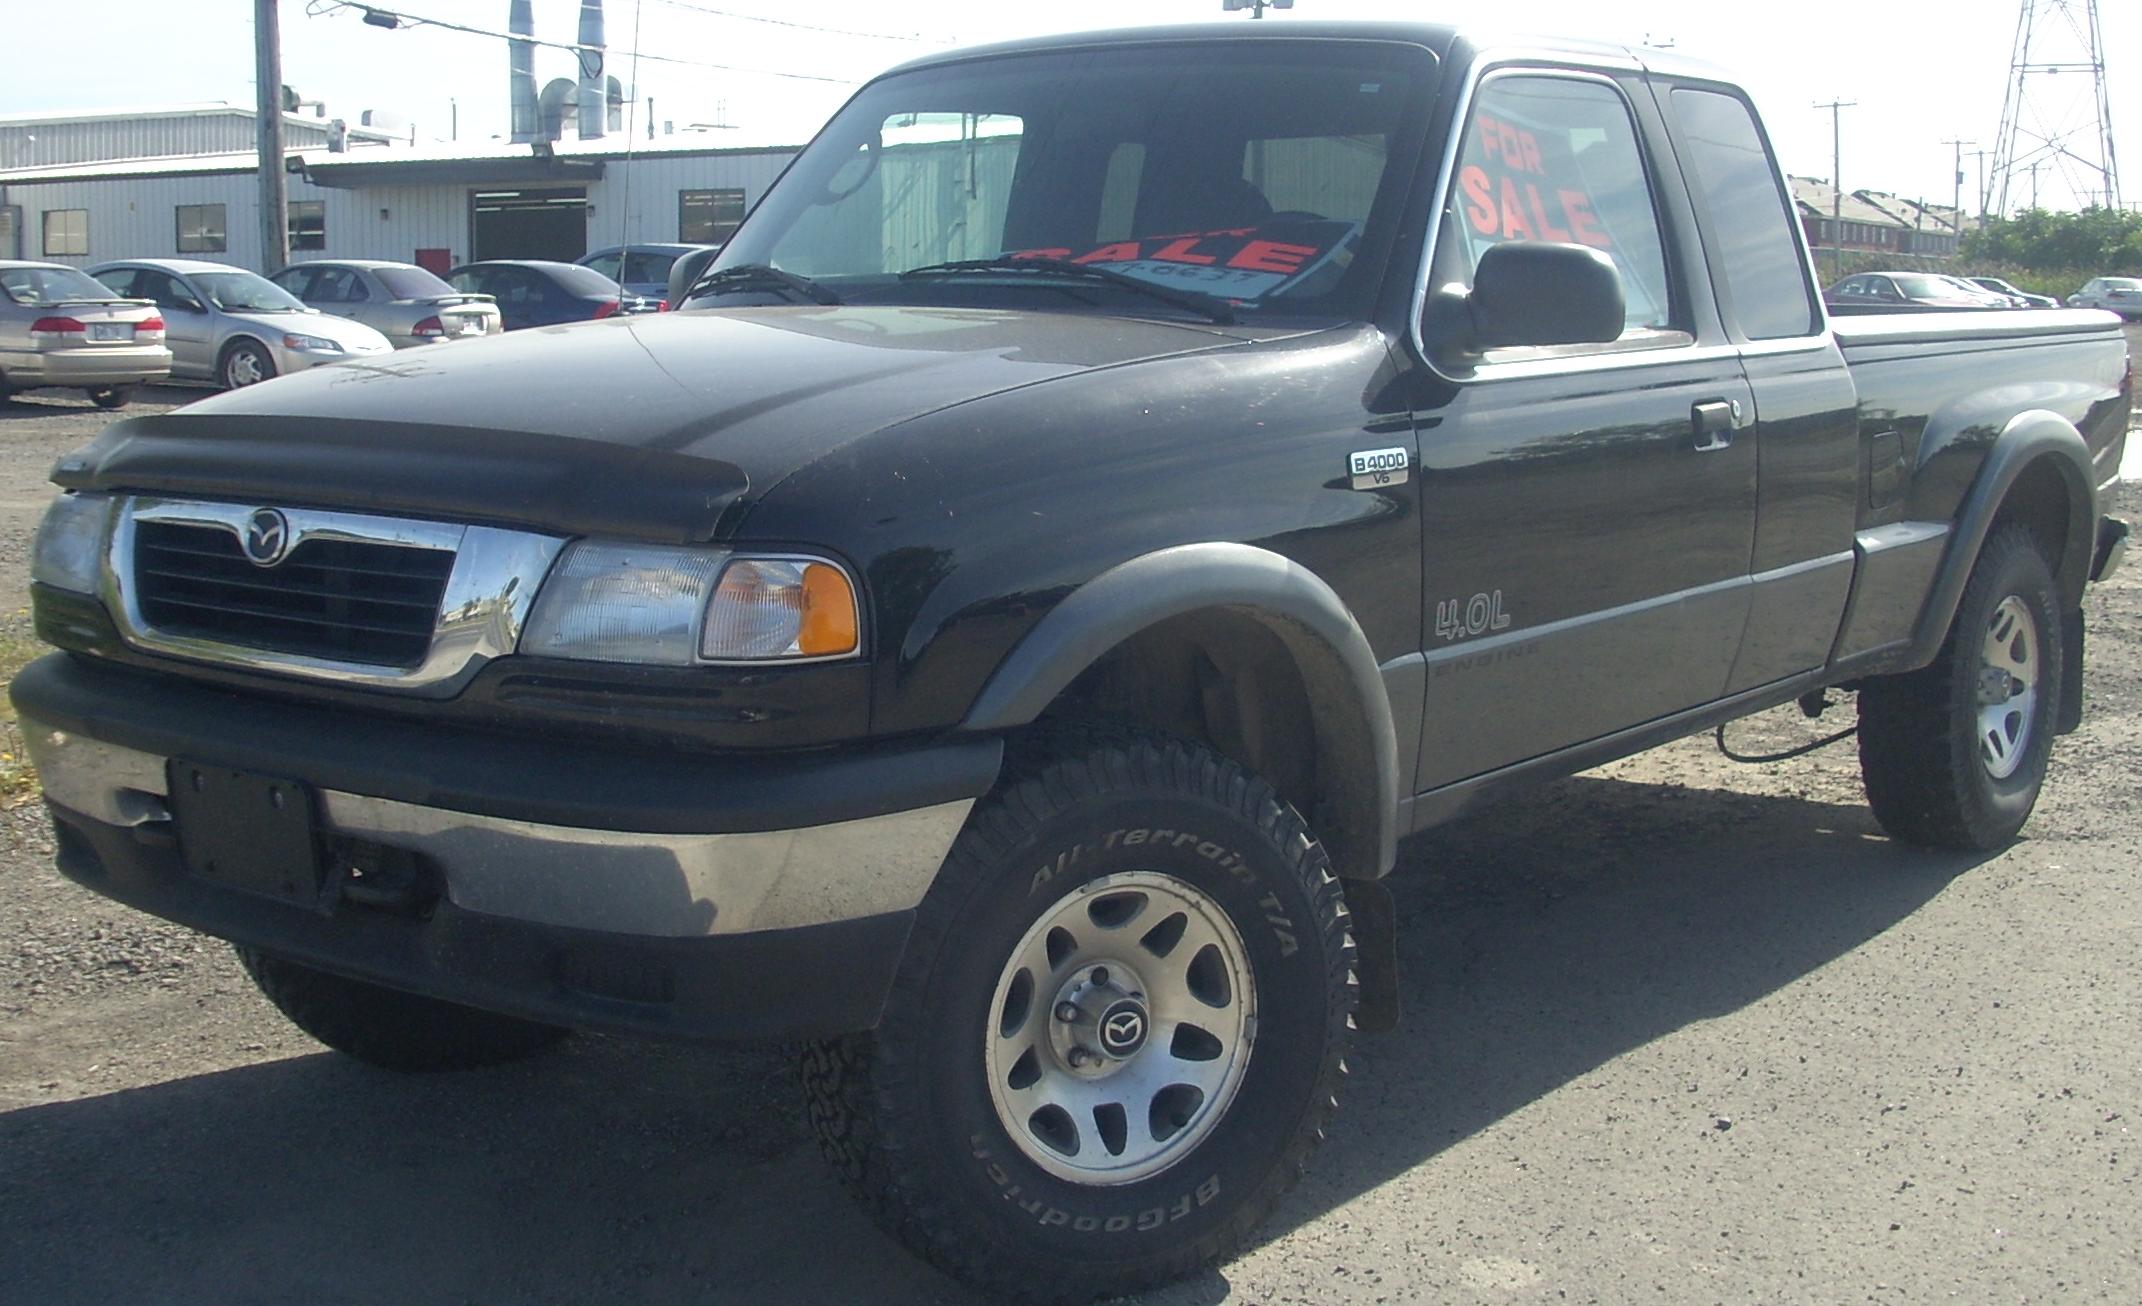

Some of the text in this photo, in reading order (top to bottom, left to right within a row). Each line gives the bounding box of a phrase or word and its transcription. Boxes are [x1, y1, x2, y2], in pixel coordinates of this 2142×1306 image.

[1477, 114, 1546, 176] FOR
[1460, 165, 1612, 247] SALE
[1354, 452, 1405, 472] B4000
[1373, 471, 1390, 485] V6
[1435, 589, 1511, 640] 4.0L
